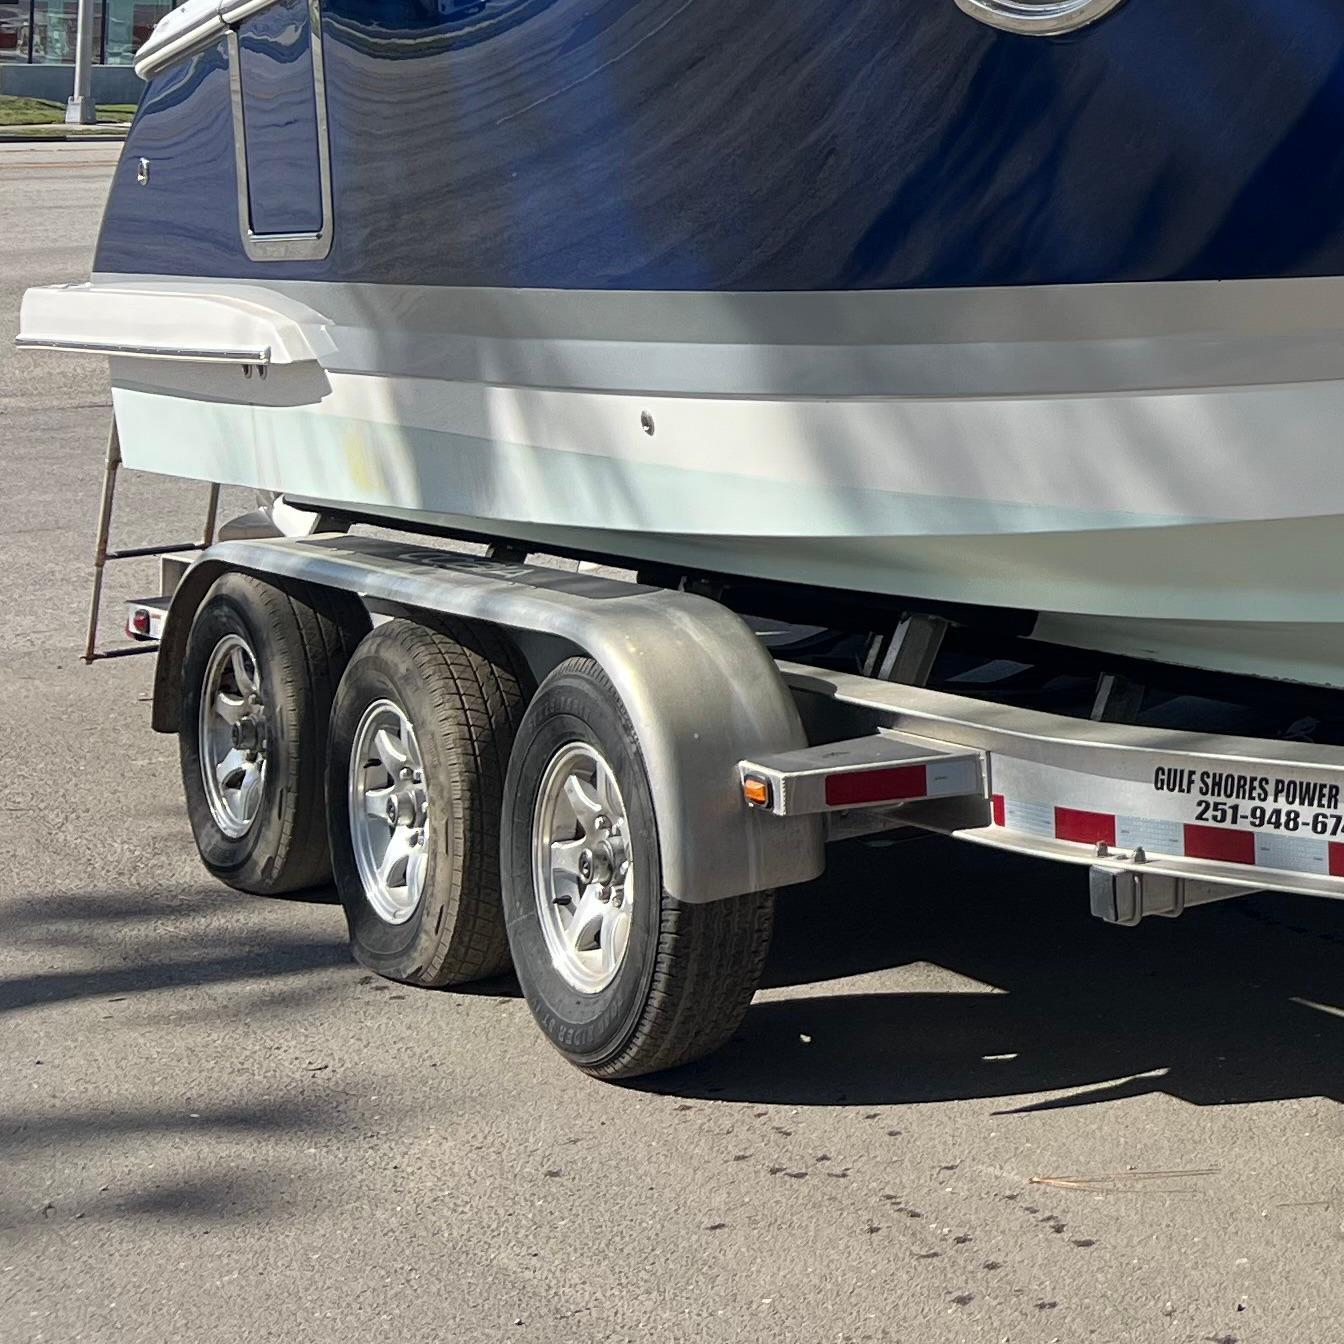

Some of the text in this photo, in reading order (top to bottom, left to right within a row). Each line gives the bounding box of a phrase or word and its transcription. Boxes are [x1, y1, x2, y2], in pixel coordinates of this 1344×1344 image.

[1154, 766, 1196, 795] GULF
[1200, 771, 1268, 801] SHORES
[1273, 778, 1338, 810] POWER
